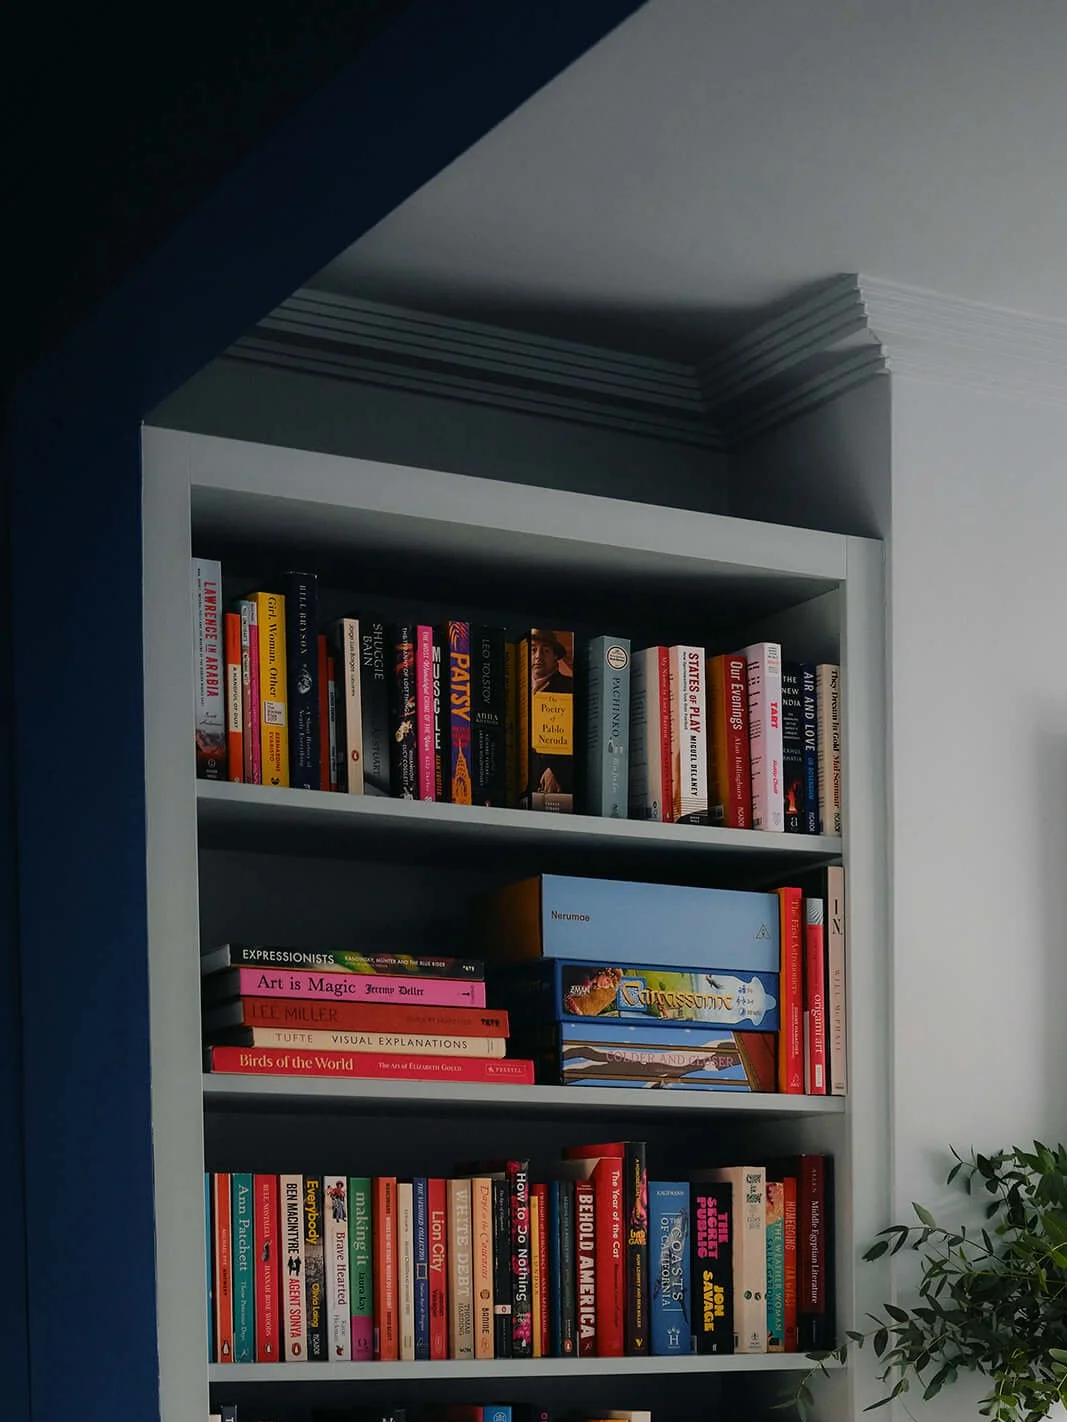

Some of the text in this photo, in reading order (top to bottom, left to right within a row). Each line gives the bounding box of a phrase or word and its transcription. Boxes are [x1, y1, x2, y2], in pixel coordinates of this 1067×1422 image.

[204, 582, 218, 641] LAWRENCE
[206, 656, 219, 698] ARABIA
[266, 596, 278, 698] Girl, Woman, Other
[362, 636, 372, 666] BAIN
[373, 624, 384, 680] SHUGGIE
[450, 652, 471, 722] PATSY
[541, 704, 566, 714] Poetry
[612, 677, 621, 738] PACHINKO
[730, 661, 745, 731] Our Evenings
[804, 672, 815, 752] AIR AND LOVE
[539, 734, 568, 746] Neruda
[542, 724, 564, 734] Pablo
[242, 948, 334, 966] EXPRESSIONISTS
[257, 976, 356, 996] Art is Magic
[251, 1004, 338, 1022] LEE MILLER
[364, 984, 424, 997] Jeremy Deller
[622, 982, 733, 1010] Carcassonne
[274, 1032, 468, 1050] TUFTE VISUAL EXPLANATIONS
[811, 994, 824, 1054] origami art
[239, 1054, 354, 1070] Birds of the World
[238, 1184, 250, 1272] Ann Patchett
[286, 1183, 300, 1254] BEN MACINTYRE
[304, 1180, 321, 1246] Everybody
[353, 1192, 369, 1266] making it
[430, 1210, 445, 1272] Lion City
[456, 1188, 471, 1297] WHITE DEBT
[696, 1196, 707, 1260] PUBLIC
[706, 1196, 718, 1260] SECRET
[718, 1212, 728, 1243] THE
[336, 1232, 346, 1305] Brave Hearted
[578, 1194, 596, 1338] BEHOLD AMERICA
[661, 1217, 672, 1306] OF CALIFORNIA
[672, 1226, 683, 1302] COASTS
[288, 1278, 302, 1338] AGENT SONYA
[703, 1270, 714, 1333] SAVAGE
[713, 1285, 724, 1316] JON
